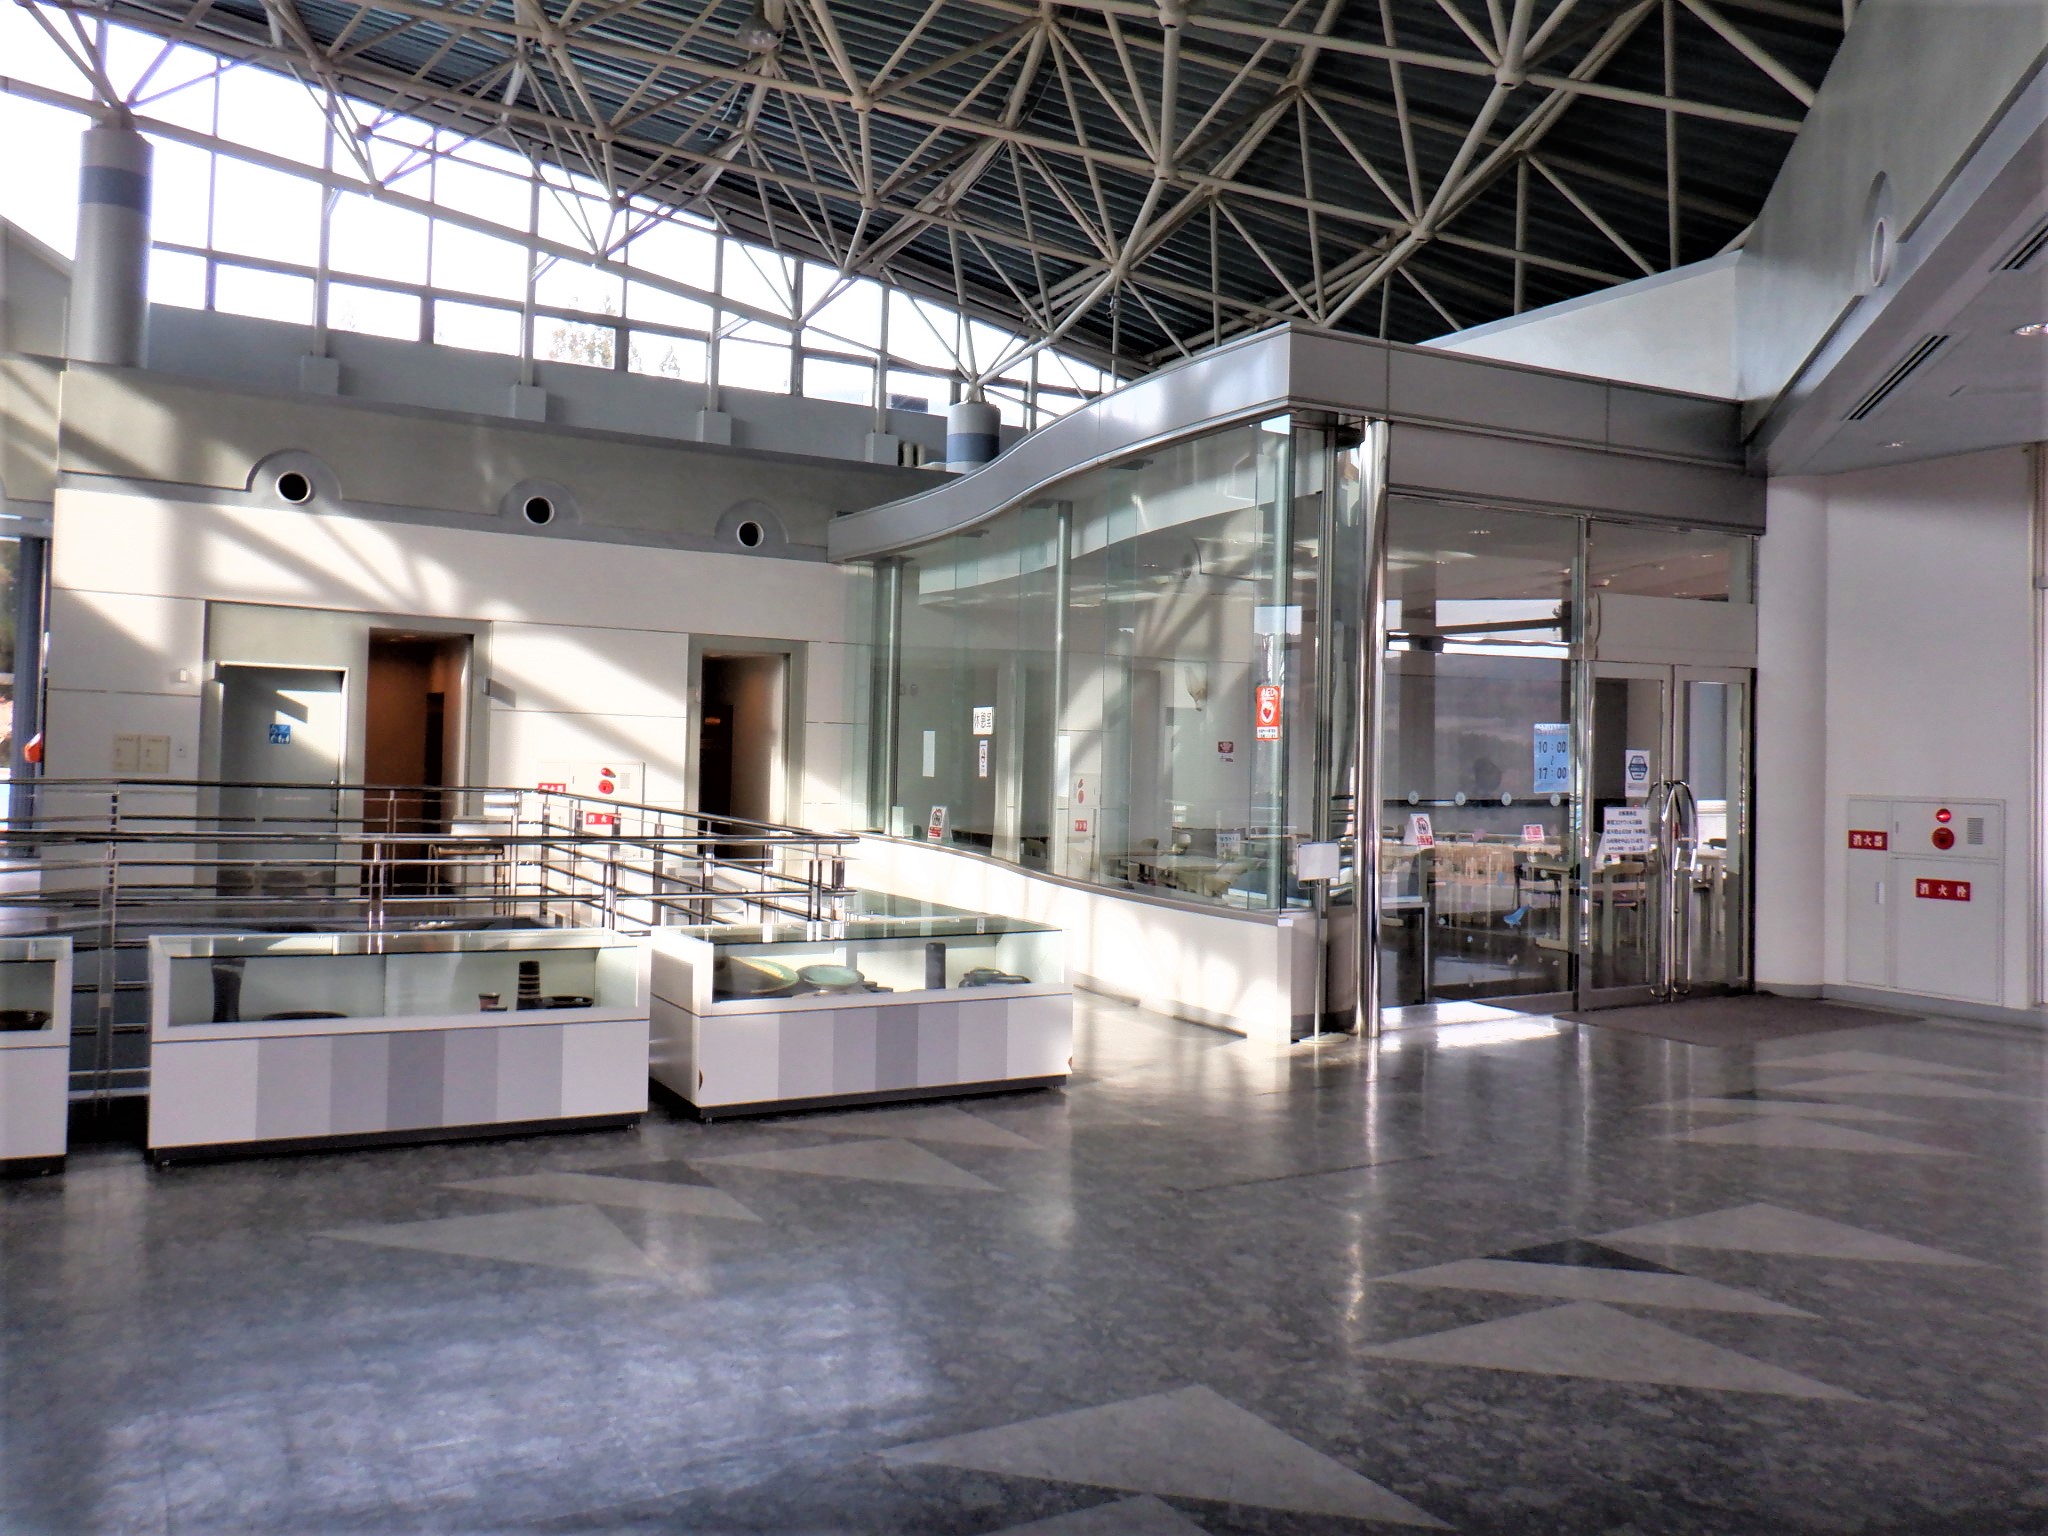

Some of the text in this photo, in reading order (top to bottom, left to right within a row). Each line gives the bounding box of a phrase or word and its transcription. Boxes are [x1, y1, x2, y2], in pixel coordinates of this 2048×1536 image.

[1261, 687, 1275, 697] AED
[1853, 834, 1883, 847] 消火器
[1920, 882, 1967, 898] 消火栓
